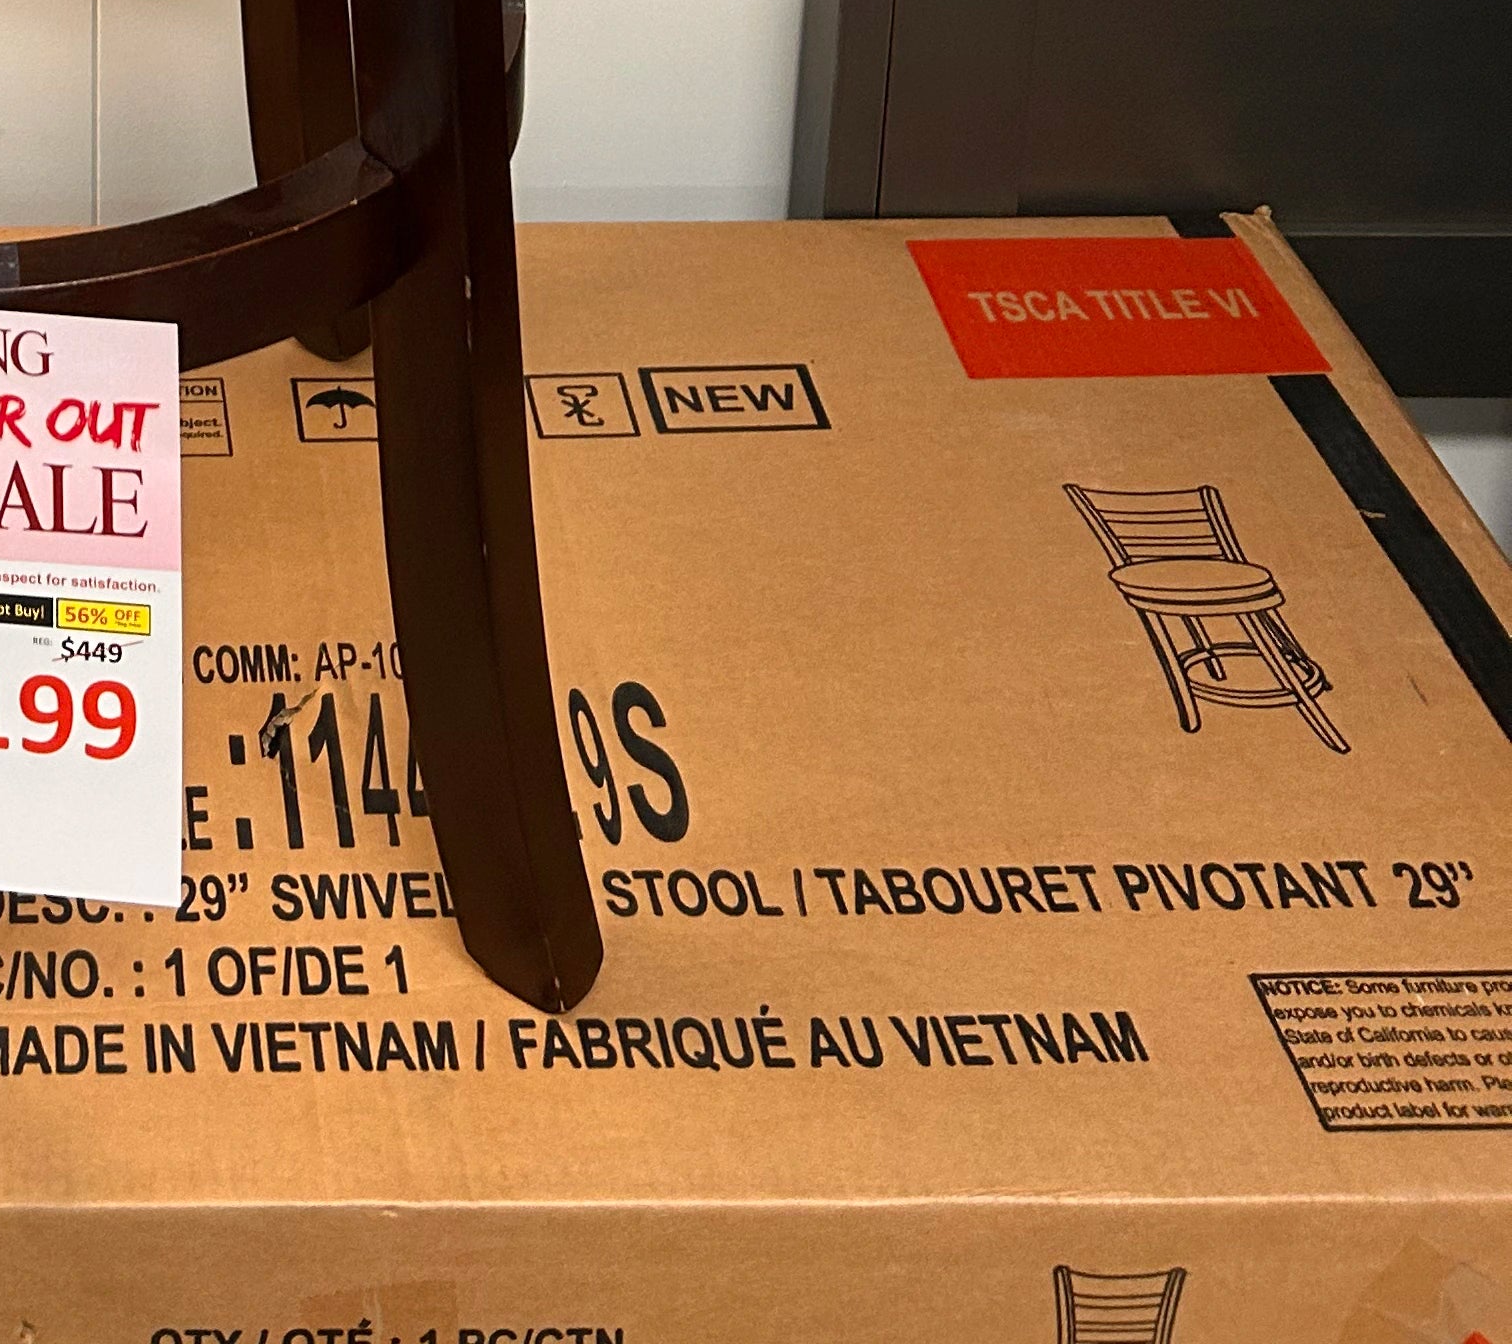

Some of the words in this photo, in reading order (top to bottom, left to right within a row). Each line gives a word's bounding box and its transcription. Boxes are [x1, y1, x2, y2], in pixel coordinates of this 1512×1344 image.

[968, 288, 1089, 324] TSCA
[1089, 288, 1209, 322] TITLE
[1209, 287, 1262, 319] VI
[663, 383, 794, 414] NEW
[46, 398, 160, 453] OUT
[46, 571, 68, 588] for
[71, 576, 161, 594] satisfaction.
[14, 603, 45, 621] Buy!
[64, 605, 108, 626] 56%
[114, 608, 141, 623] OFF
[61, 635, 123, 663] $449
[192, 643, 302, 684] COMM:
[270, 871, 457, 922] SWIVEL
[601, 868, 785, 918] STOOL
[793, 867, 808, 918] /
[814, 863, 1104, 916] TABOURET
[1112, 861, 1378, 912] PIVOTANT
[164, 946, 186, 997] 1
[207, 944, 369, 997] OF/DE
[384, 944, 409, 995] 1
[1259, 979, 1344, 997] NOTICE:
[1344, 979, 1401, 995] Some
[1400, 978, 1479, 995] furniture
[1273, 1004, 1339, 1023] expose
[1339, 1005, 1376, 1023] you
[1377, 1002, 1398, 1018] to
[1400, 1001, 1493, 1018] chemicals
[144, 1023, 196, 1074] IN
[210, 1019, 461, 1074] VIETNAM
[508, 1003, 796, 1072] FABRIQUÉ
[809, 1015, 885, 1069] AU
[889, 1011, 1150, 1068] VIETNAM
[1283, 1027, 1333, 1046] State
[1336, 1026, 1356, 1044] of
[1356, 1025, 1445, 1043] California
[1445, 1026, 1468, 1043] to
[1296, 1052, 1355, 1070] and/or
[1356, 1051, 1401, 1068] birth
[1402, 1050, 1472, 1068] defects
[1473, 1052, 1495, 1067] or
[1308, 1076, 1423, 1097] reproductive
[1318, 1101, 1394, 1123] product
[1392, 1100, 1442, 1119] label
[1441, 1100, 1471, 1119] for
